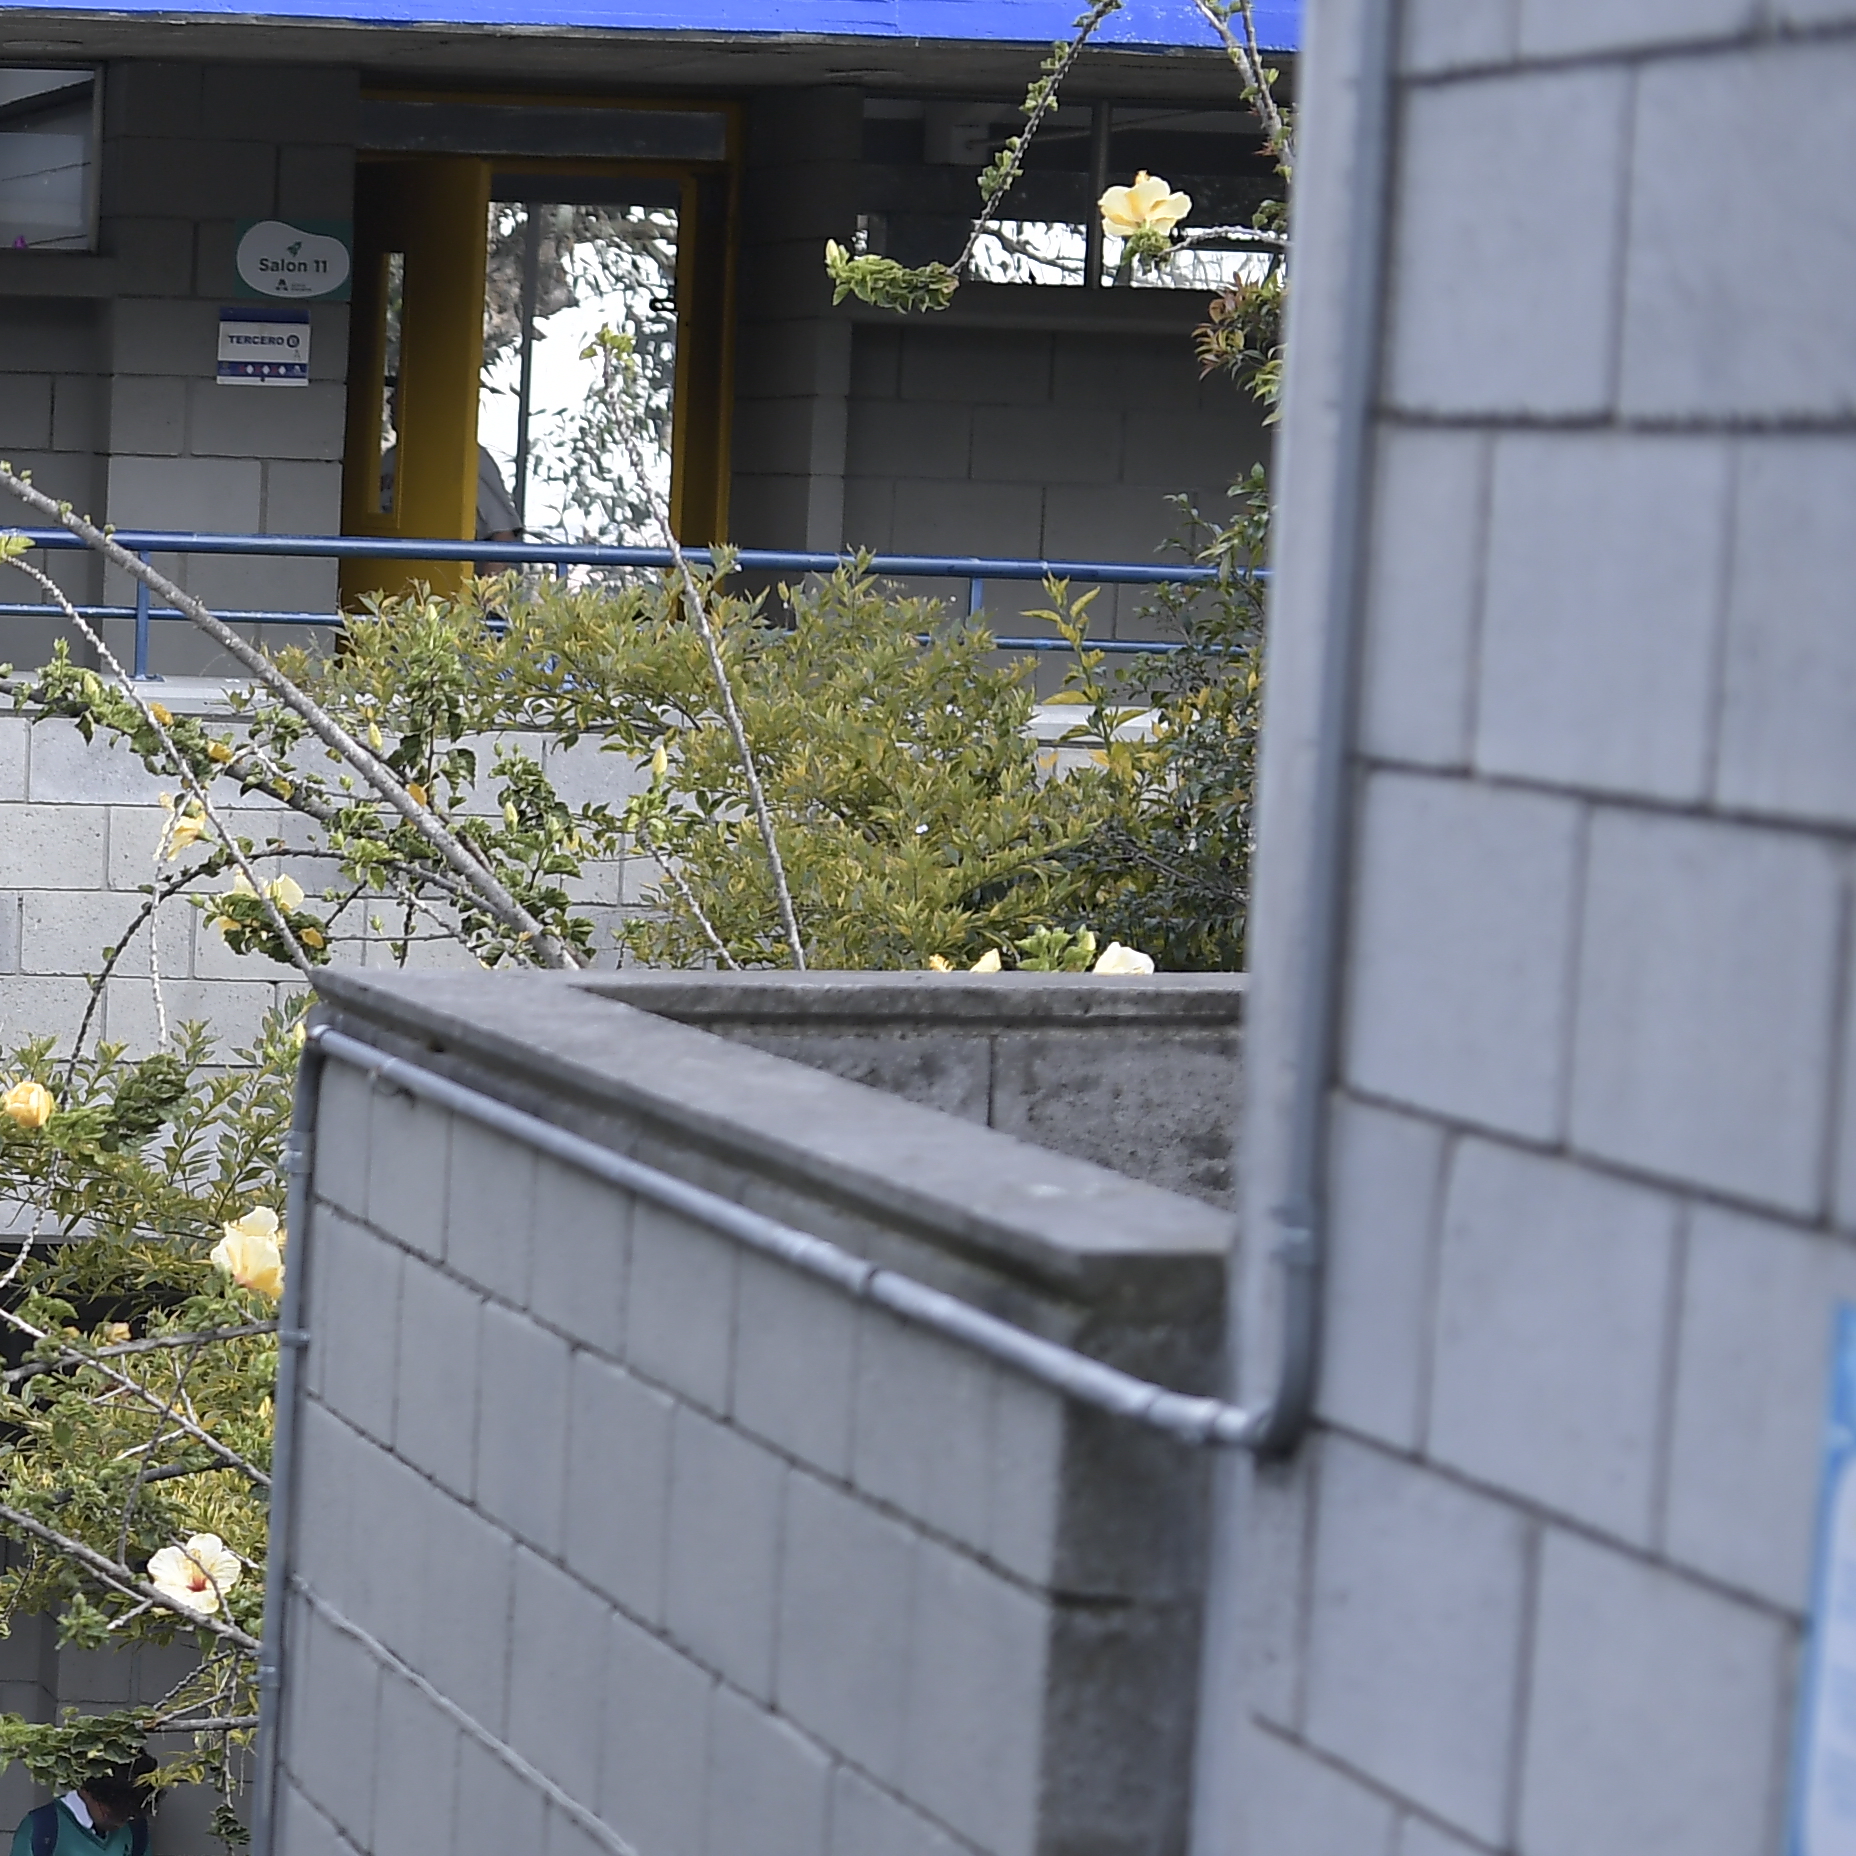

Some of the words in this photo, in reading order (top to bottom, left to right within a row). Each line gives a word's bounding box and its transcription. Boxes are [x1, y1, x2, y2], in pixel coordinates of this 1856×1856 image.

[259, 258, 307, 273] Salon
[314, 260, 327, 273] 11
[228, 335, 284, 345] TERCERO
